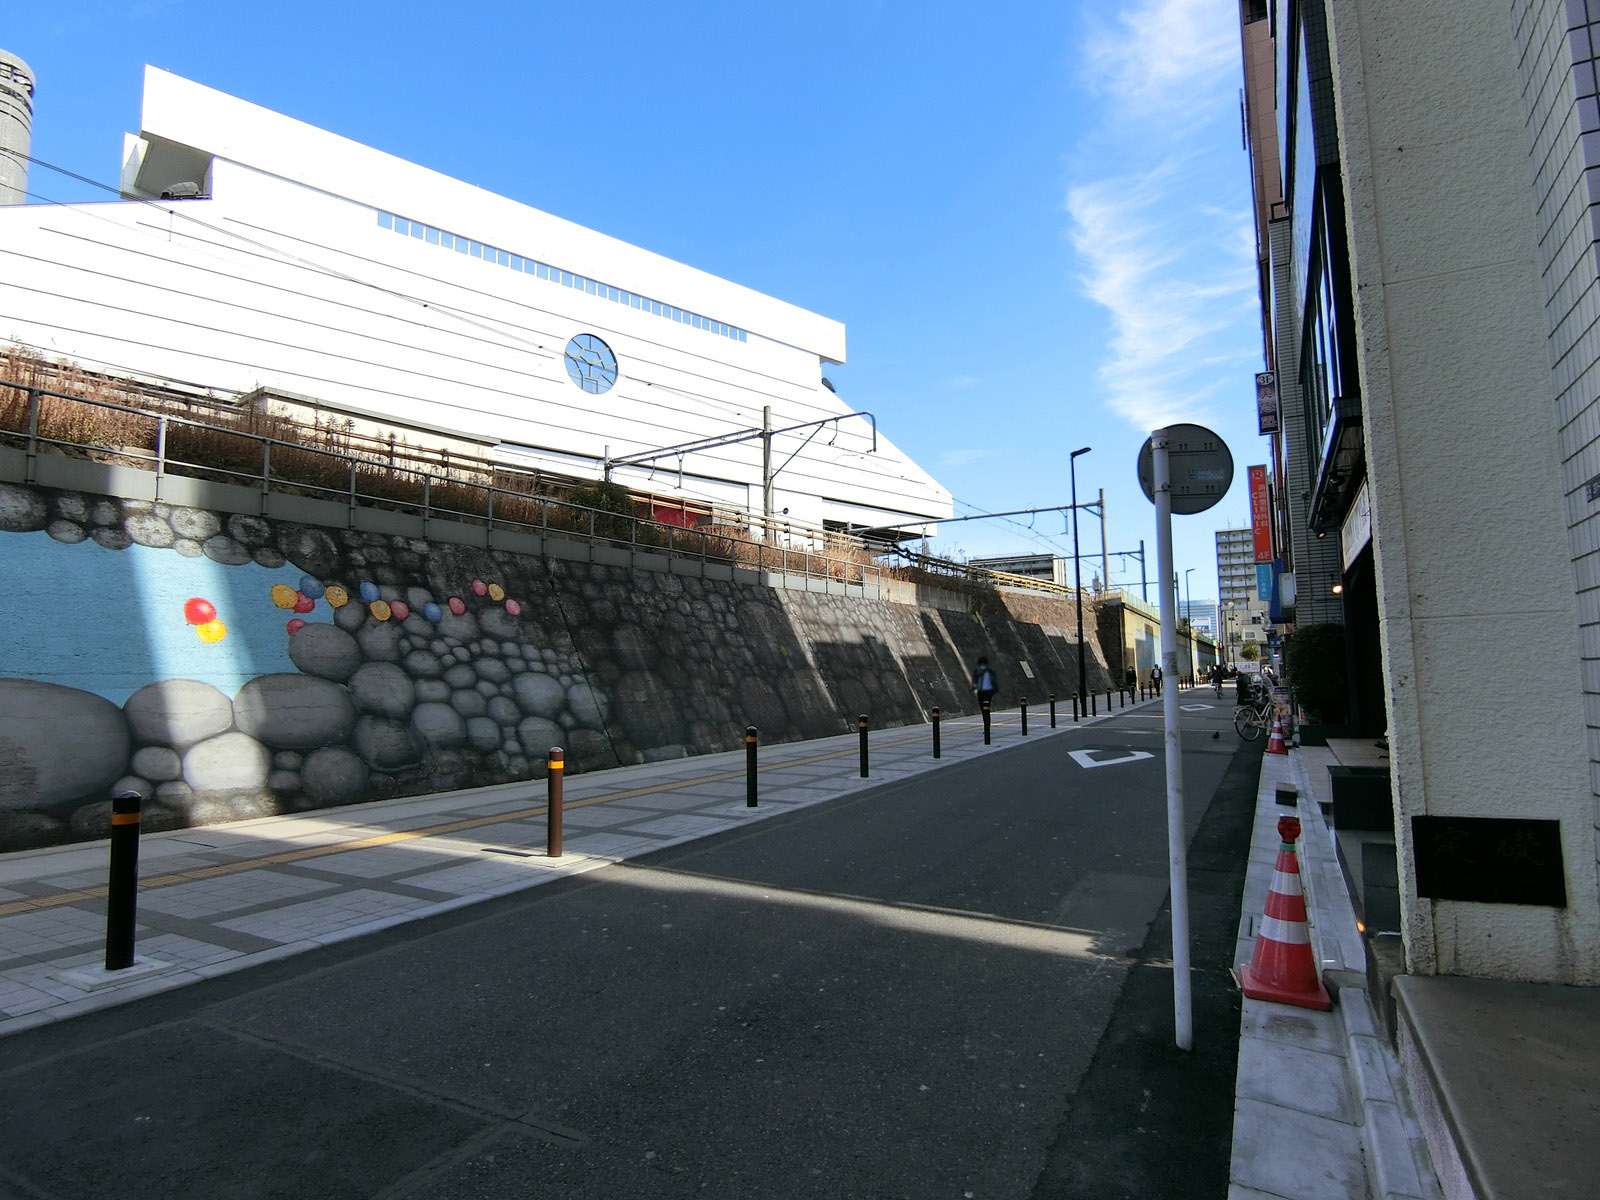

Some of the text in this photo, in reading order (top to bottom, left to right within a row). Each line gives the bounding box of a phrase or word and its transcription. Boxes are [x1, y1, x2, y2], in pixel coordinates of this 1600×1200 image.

[1258, 375, 1273, 385] 3F
[1251, 492, 1262, 535] CLINIC
[1257, 551, 1270, 560] 4F
